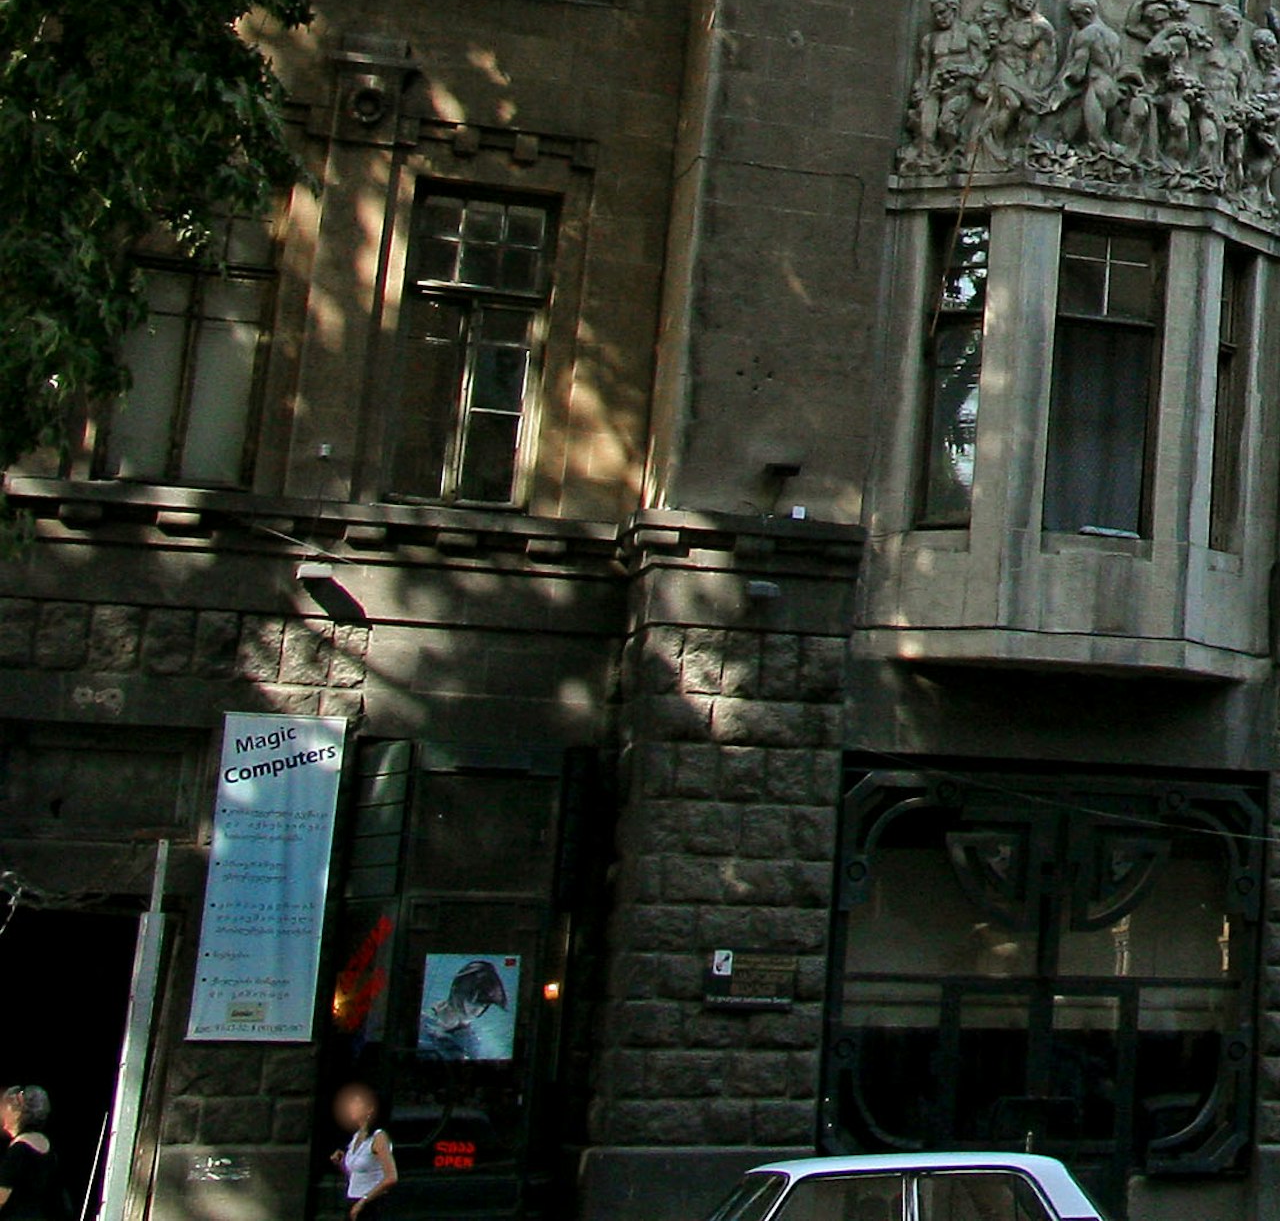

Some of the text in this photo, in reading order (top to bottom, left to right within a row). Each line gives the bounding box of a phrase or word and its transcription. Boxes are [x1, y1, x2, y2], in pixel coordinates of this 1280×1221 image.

[235, 726, 297, 754] Magic
[224, 745, 337, 784] Computers
[434, 1155, 474, 1170] OPEN
